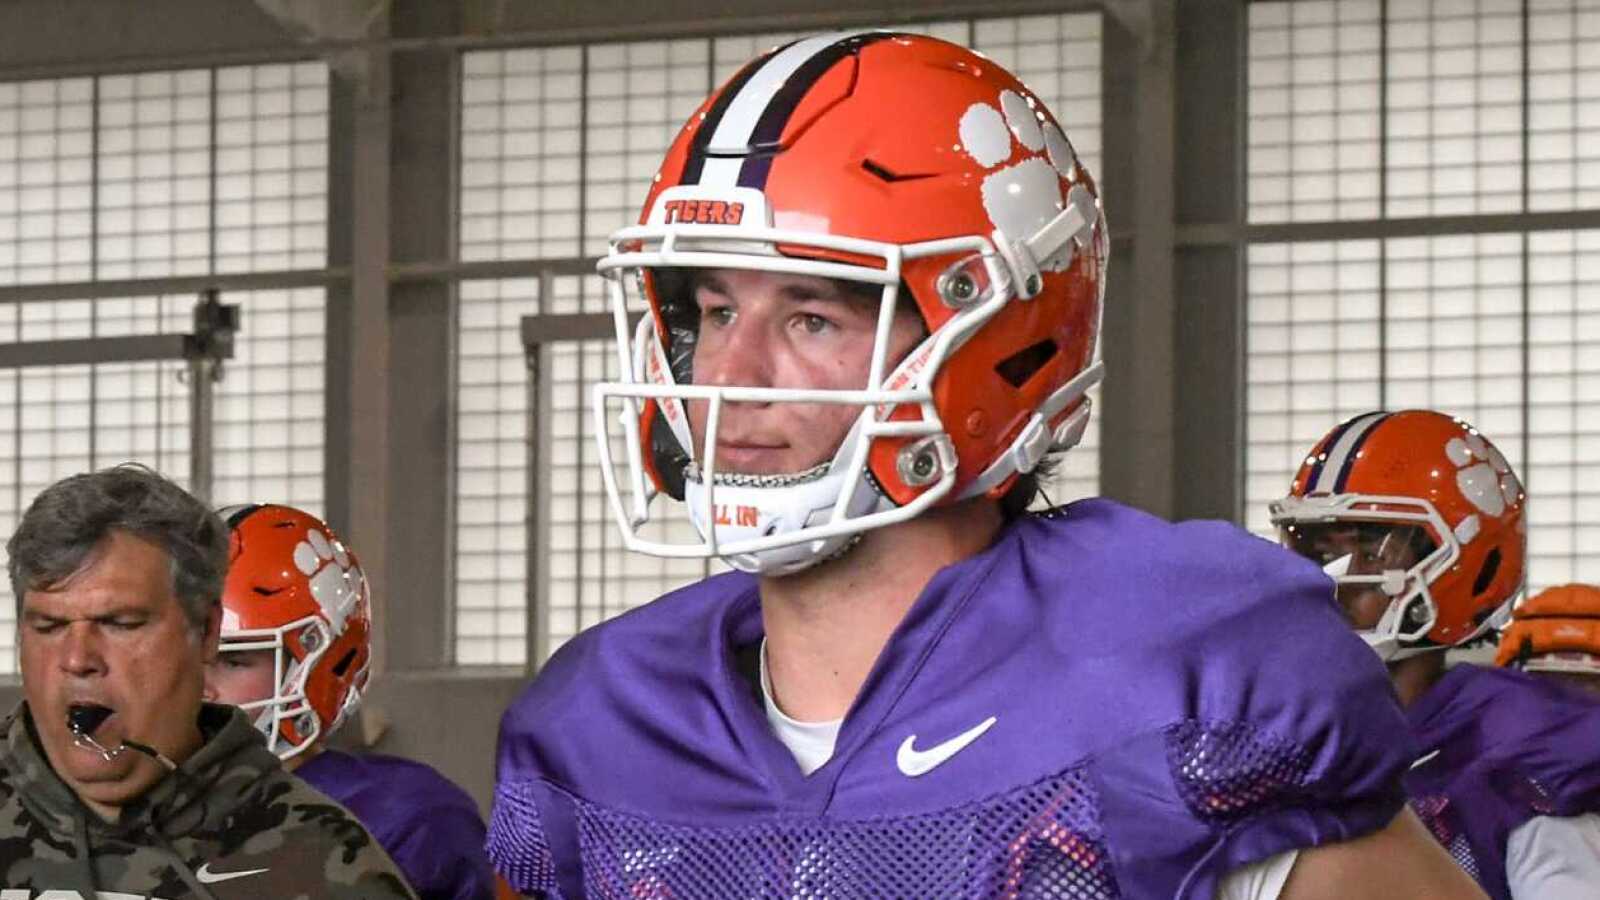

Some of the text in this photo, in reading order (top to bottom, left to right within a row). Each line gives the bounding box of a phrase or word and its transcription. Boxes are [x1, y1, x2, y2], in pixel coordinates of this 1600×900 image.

[664, 199, 744, 225] TIGERS
[711, 504, 759, 527] LL IN
